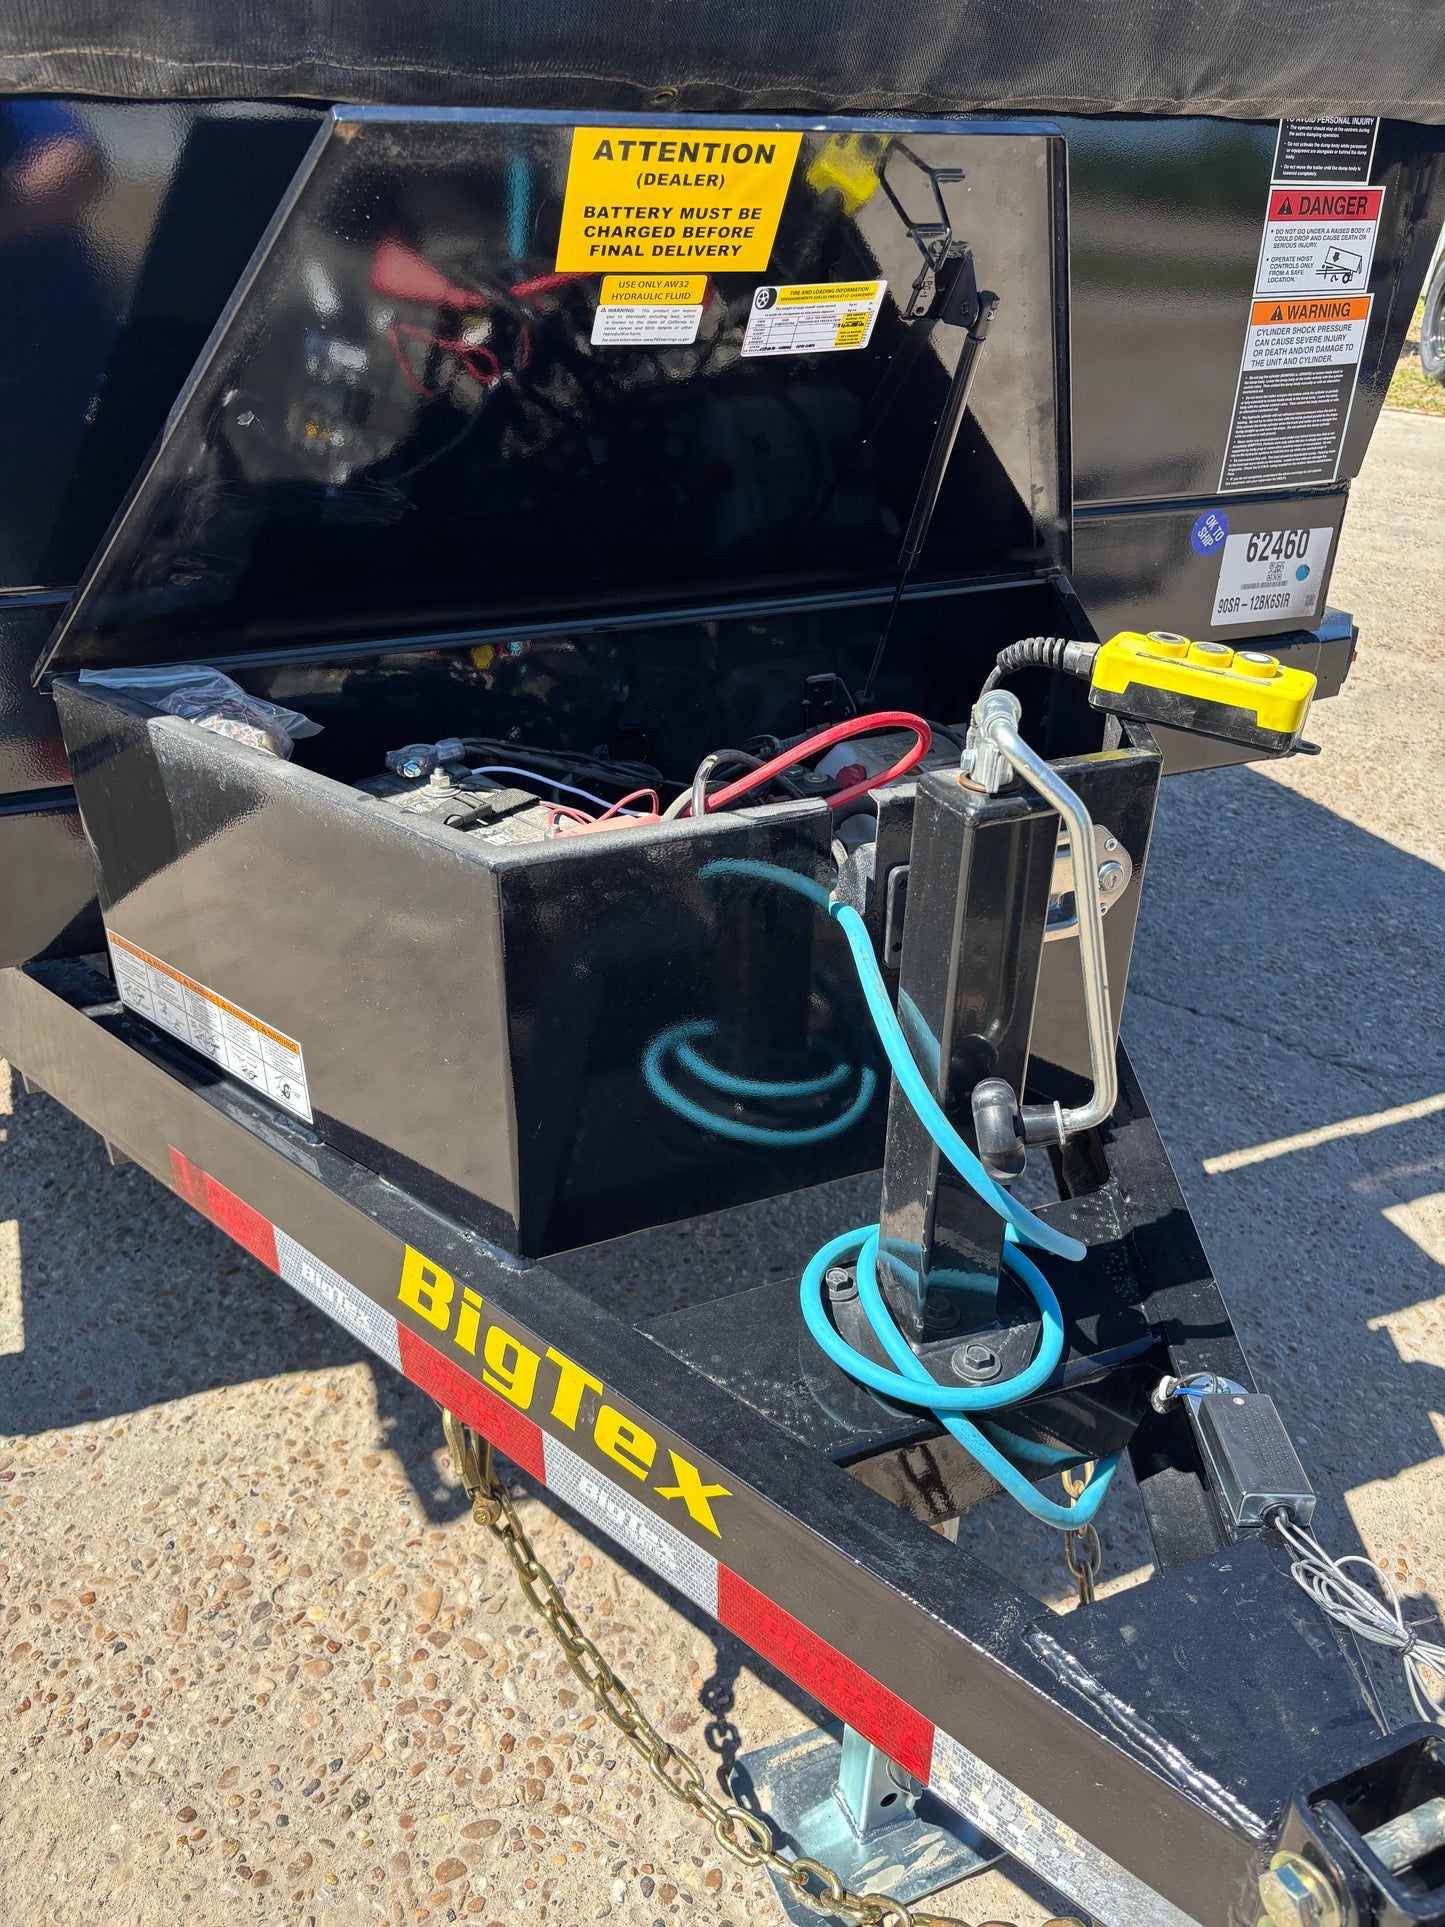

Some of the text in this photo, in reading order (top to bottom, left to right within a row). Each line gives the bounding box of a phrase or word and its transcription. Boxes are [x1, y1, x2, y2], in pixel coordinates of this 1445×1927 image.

[592, 139, 776, 164] ATTENTION
[636, 173, 725, 190] (DEALER)
[583, 206, 762, 220] BATTERY MUST BE
[1299, 196, 1368, 215] DANGER
[584, 226, 754, 239] CHARGED BEFORE
[589, 245, 742, 256] FINAL DELIVERY
[1287, 303, 1351, 320] WARNING
[1257, 324, 1352, 336] CYLINDER SHOCK PRESSURE
[1271, 337, 1294, 346] CAUSE
[1296, 336, 1322, 344] SEVERE
[1323, 334, 1347, 343] INJURY
[1265, 347, 1287, 356] DEATH
[1288, 346, 1313, 355] AND/OR
[1316, 344, 1343, 353] DAMAGE
[1283, 357, 1297, 365] AND
[1299, 355, 1332, 364] CYLINDER.
[1197, 527, 1213, 547] SHIP
[1206, 515, 1224, 542] OK TO
[1246, 529, 1310, 562] 62460
[397, 1243, 732, 1539] BigTex
